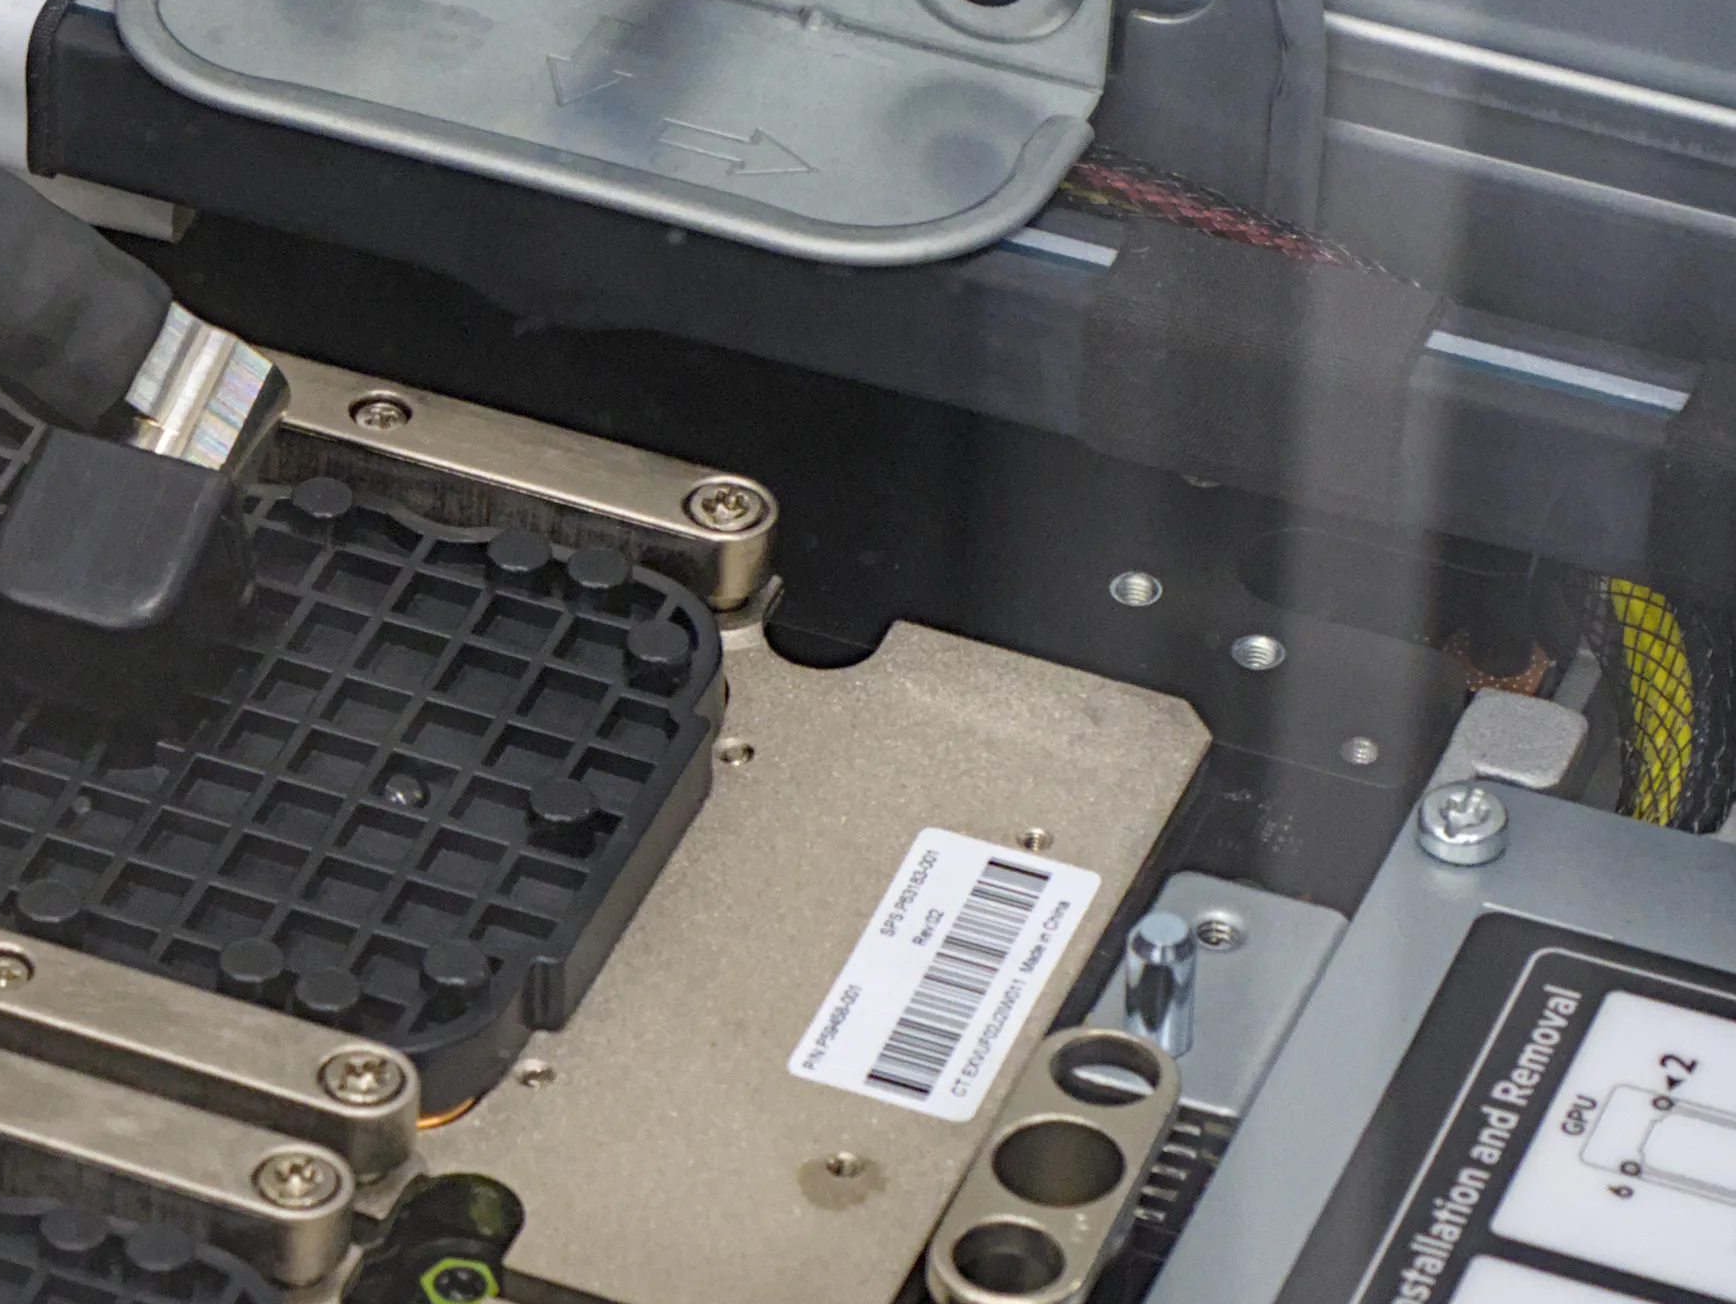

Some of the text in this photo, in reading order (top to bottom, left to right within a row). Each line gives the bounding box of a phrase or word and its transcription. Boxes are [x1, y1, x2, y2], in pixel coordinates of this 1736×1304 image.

[1019, 940, 1046, 975] Made
[1042, 899, 1072, 933] China
[1494, 983, 1584, 1110] Removal
[1659, 1052, 1700, 1076] 2
[1470, 1104, 1520, 1166] and
[1560, 1094, 1598, 1137] GPU
